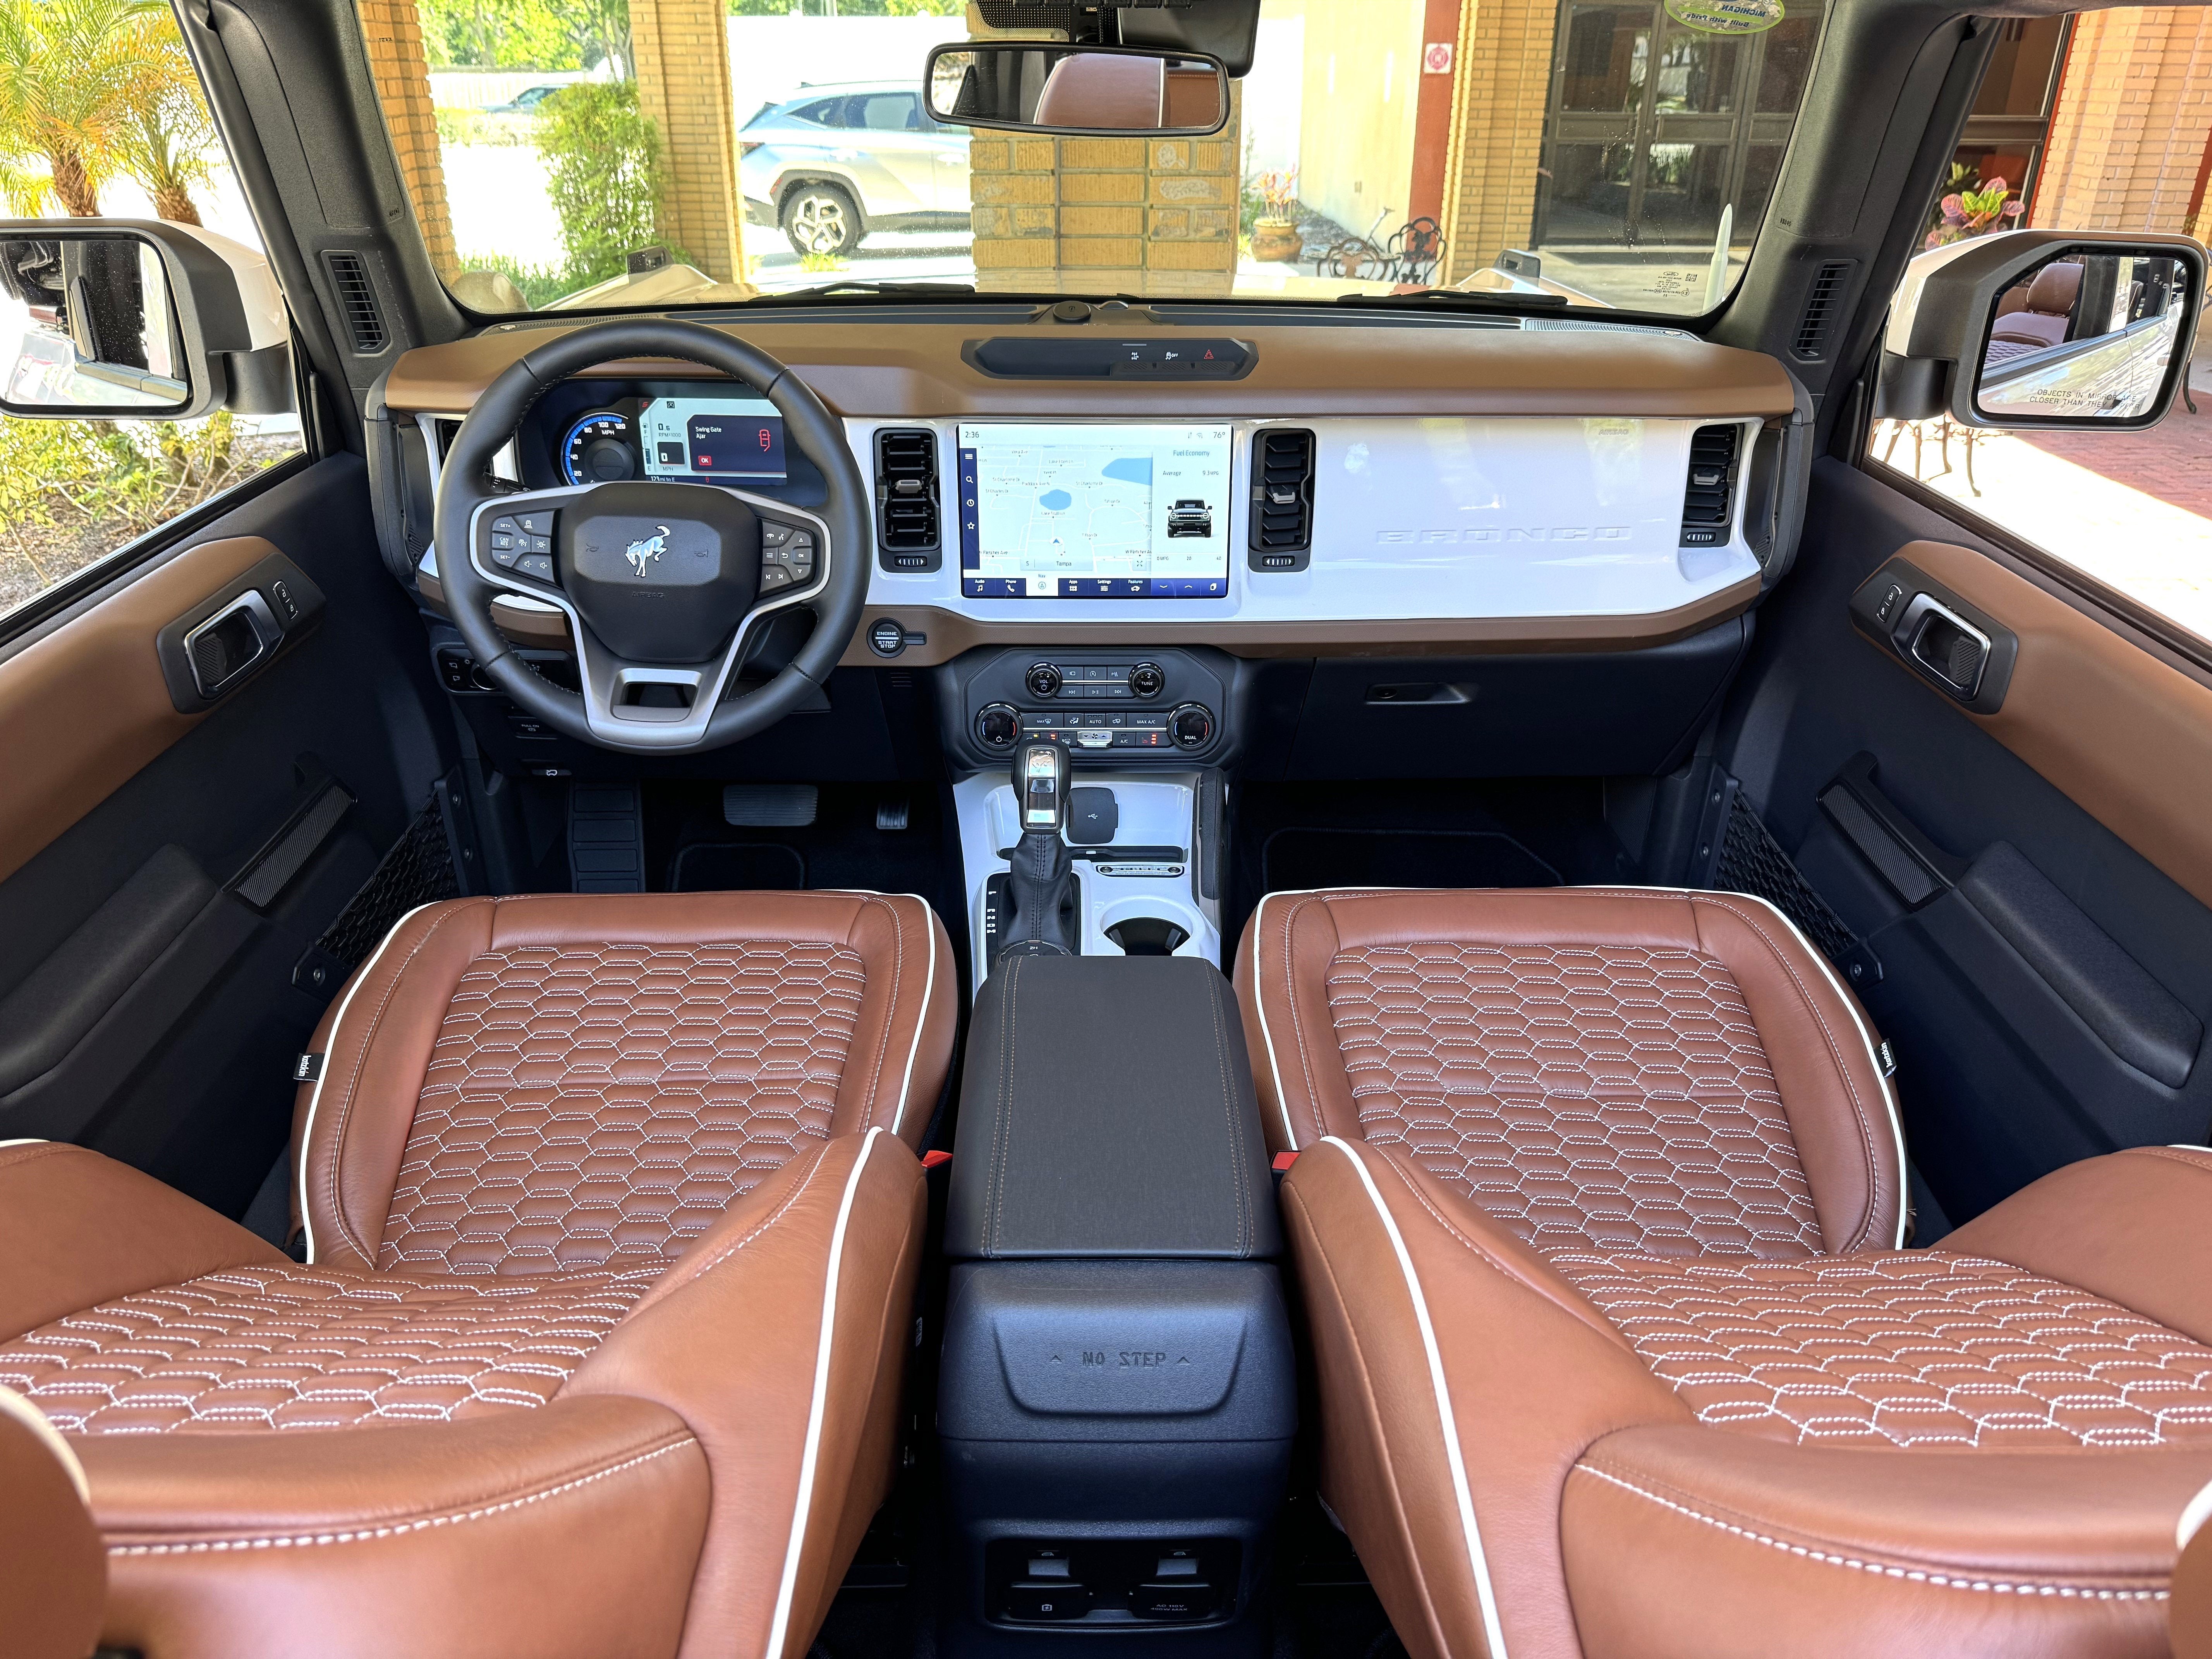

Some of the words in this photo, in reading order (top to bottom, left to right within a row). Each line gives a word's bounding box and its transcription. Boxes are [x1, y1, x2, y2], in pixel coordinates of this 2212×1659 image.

[661, 453, 668, 462] 0
[1881, 1042, 1893, 1068] katzkin
[299, 1055, 311, 1077] katzkin
[1082, 1352, 1105, 1367] NO
[1119, 1352, 1166, 1367] STEP
